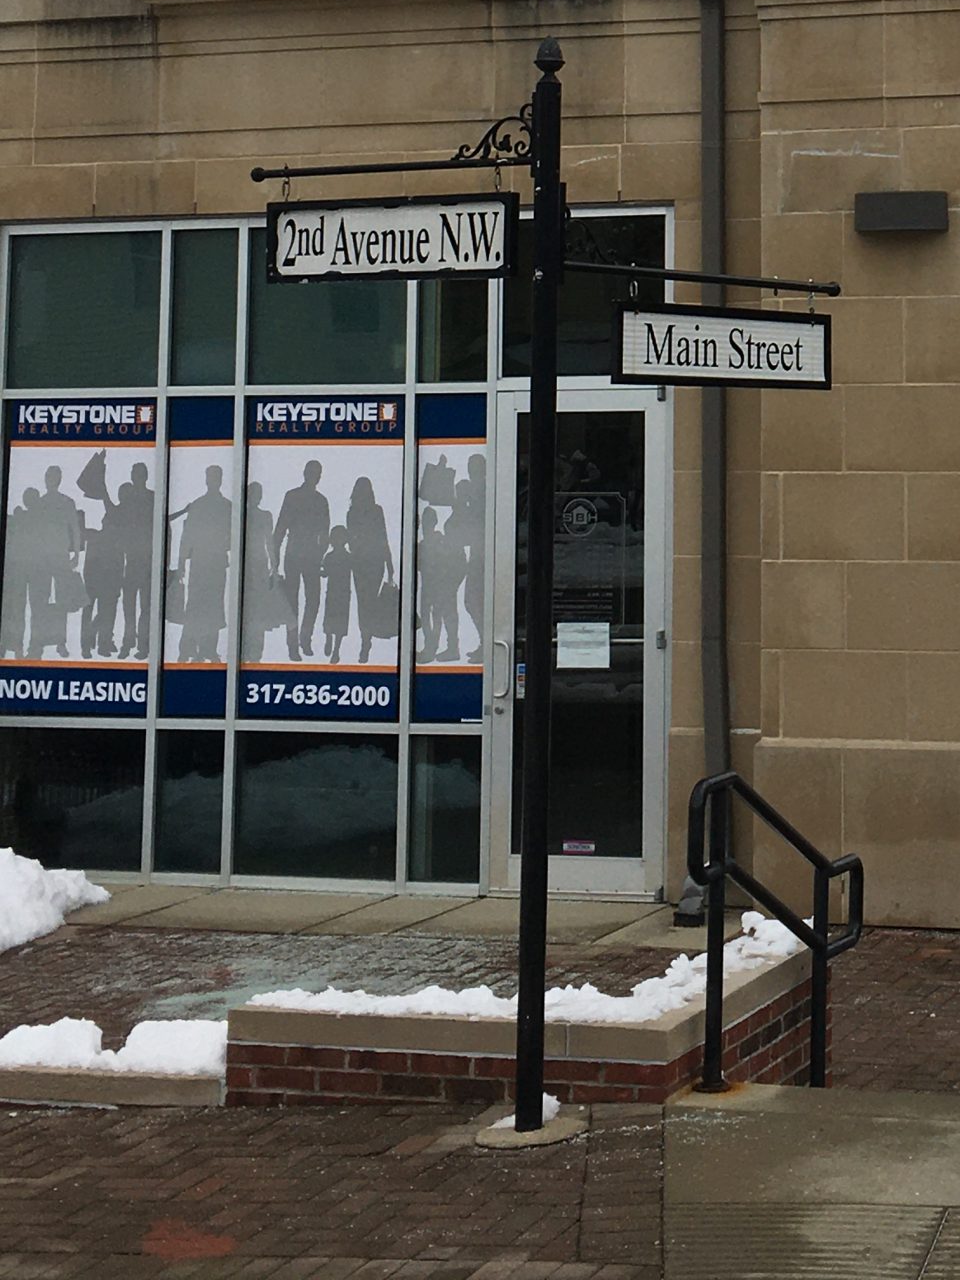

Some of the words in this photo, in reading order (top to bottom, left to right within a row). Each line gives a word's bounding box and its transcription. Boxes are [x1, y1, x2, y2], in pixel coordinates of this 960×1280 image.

[282, 215, 324, 267] 2nd
[330, 217, 430, 266] Avenue
[438, 211, 501, 263] N.W.
[643, 323, 719, 368] Main
[728, 328, 803, 371] Street
[18, 404, 135, 424] KEYSTONE
[256, 402, 378, 422] KEYSTONE
[18, 424, 82, 434] REALTY
[94, 424, 154, 434] GROUP
[256, 422, 323, 433] REALTY
[335, 422, 397, 433] GROUP
[0, 679, 52, 700] NOW
[58, 681, 146, 703] LEASING
[246, 683, 390, 706] 317-636-2000
